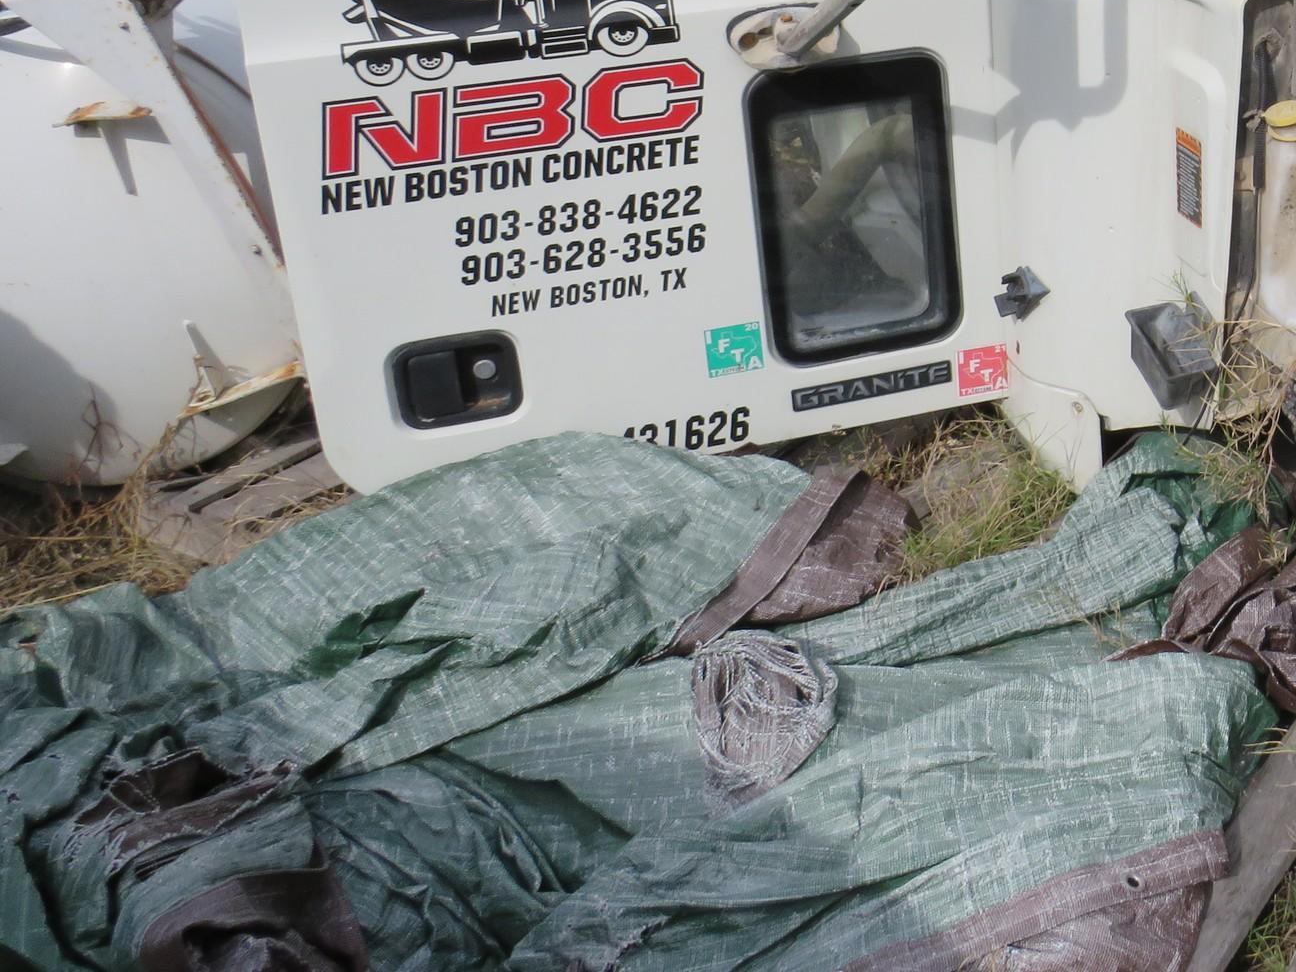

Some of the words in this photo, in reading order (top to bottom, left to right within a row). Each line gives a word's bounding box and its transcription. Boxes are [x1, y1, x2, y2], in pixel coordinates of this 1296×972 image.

[321, 58, 704, 177] NBC
[321, 176, 395, 215] NEW
[404, 157, 532, 203] BOSTON
[541, 136, 700, 183] CONCRETE
[454, 185, 702, 248] 903-838-4622
[460, 223, 707, 286] 903-628-3556
[491, 289, 541, 317] NEW
[550, 274, 649, 308] BOSTON,
[660, 267, 687, 292] TX
[744, 323, 759, 332] 20
[795, 364, 949, 408] GRANITE
[624, 406, 750, 450] 31626
